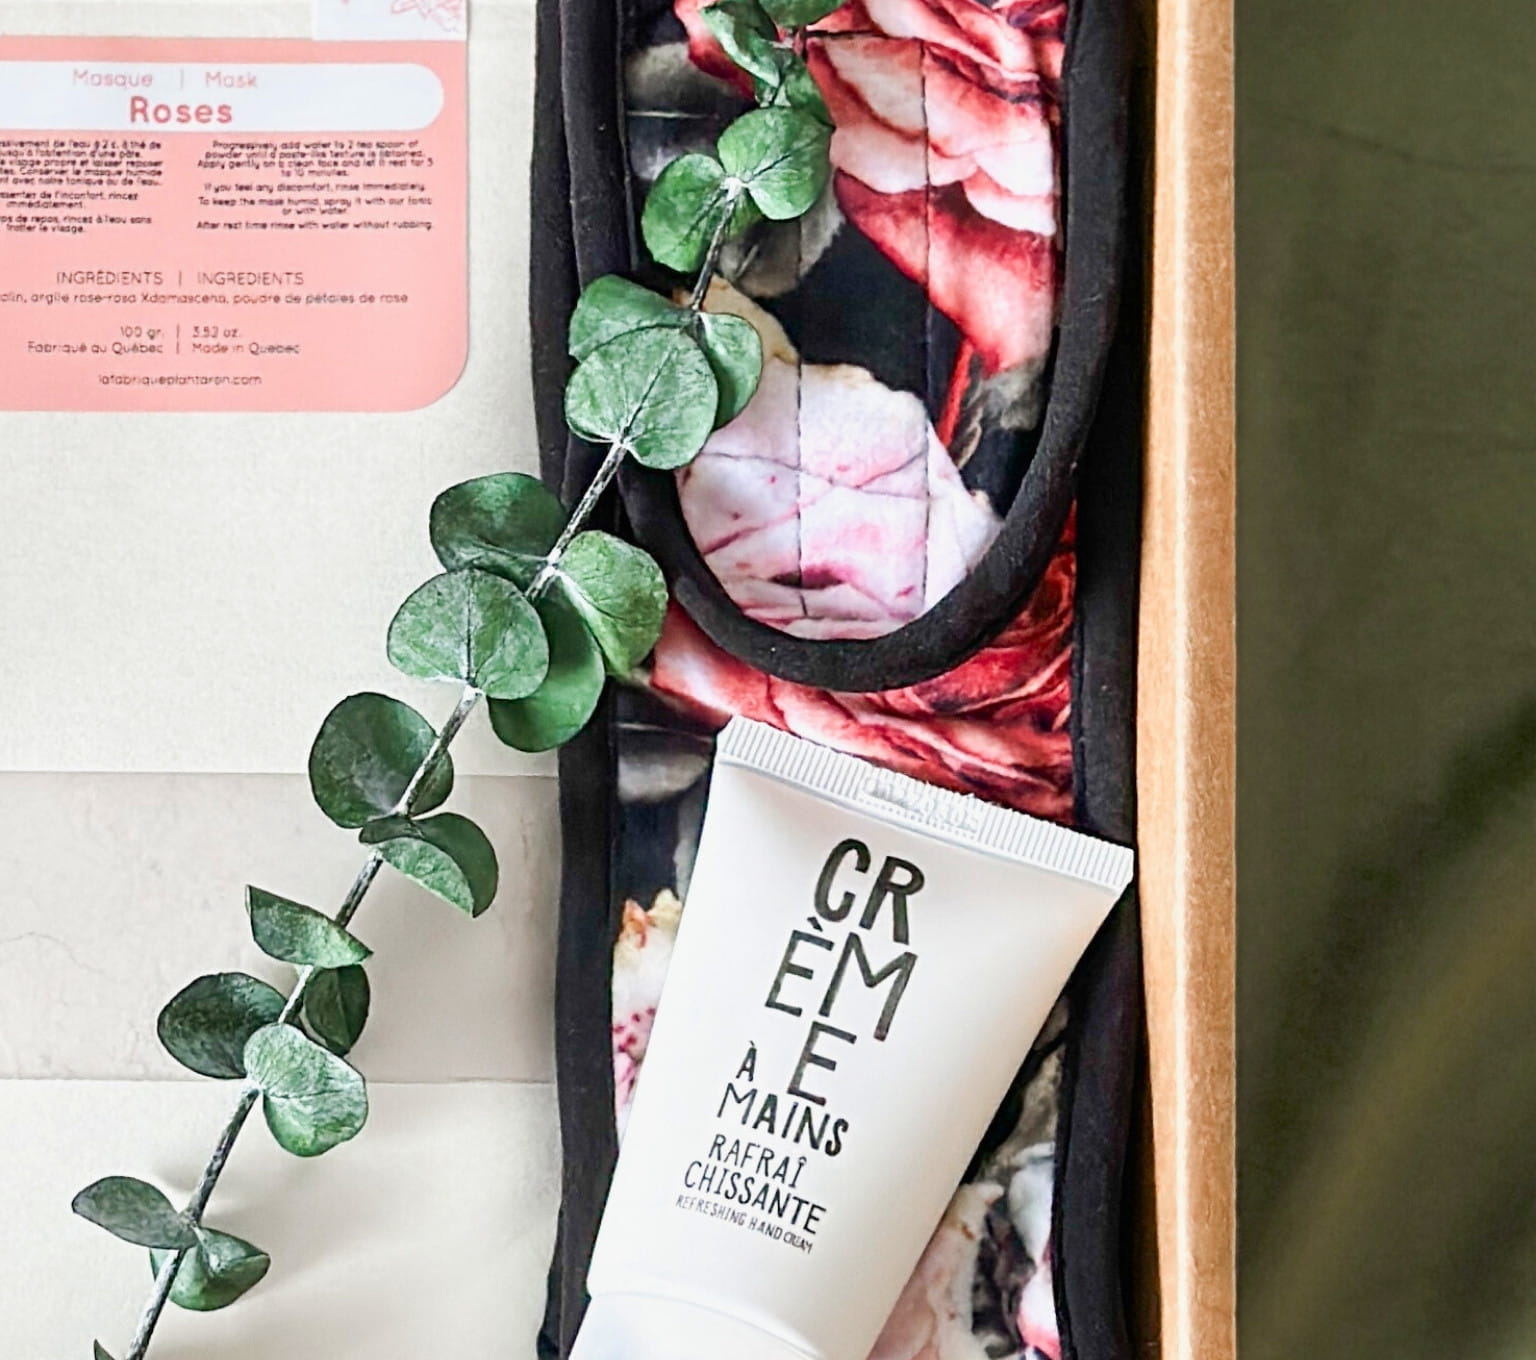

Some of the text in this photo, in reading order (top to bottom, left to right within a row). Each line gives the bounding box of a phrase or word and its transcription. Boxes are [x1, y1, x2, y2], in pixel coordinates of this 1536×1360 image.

[72, 68, 258, 89] Masque Mask
[129, 94, 234, 124] Roses
[56, 270, 304, 285] INGRÉDIENTS INGREDIENTS
[735, 1040, 757, 1082] À
[716, 1082, 851, 1157] MAINS
[684, 1160, 827, 1235] CHISSANTE
[675, 1194, 813, 1255] REFRESHING HAND CREAM
